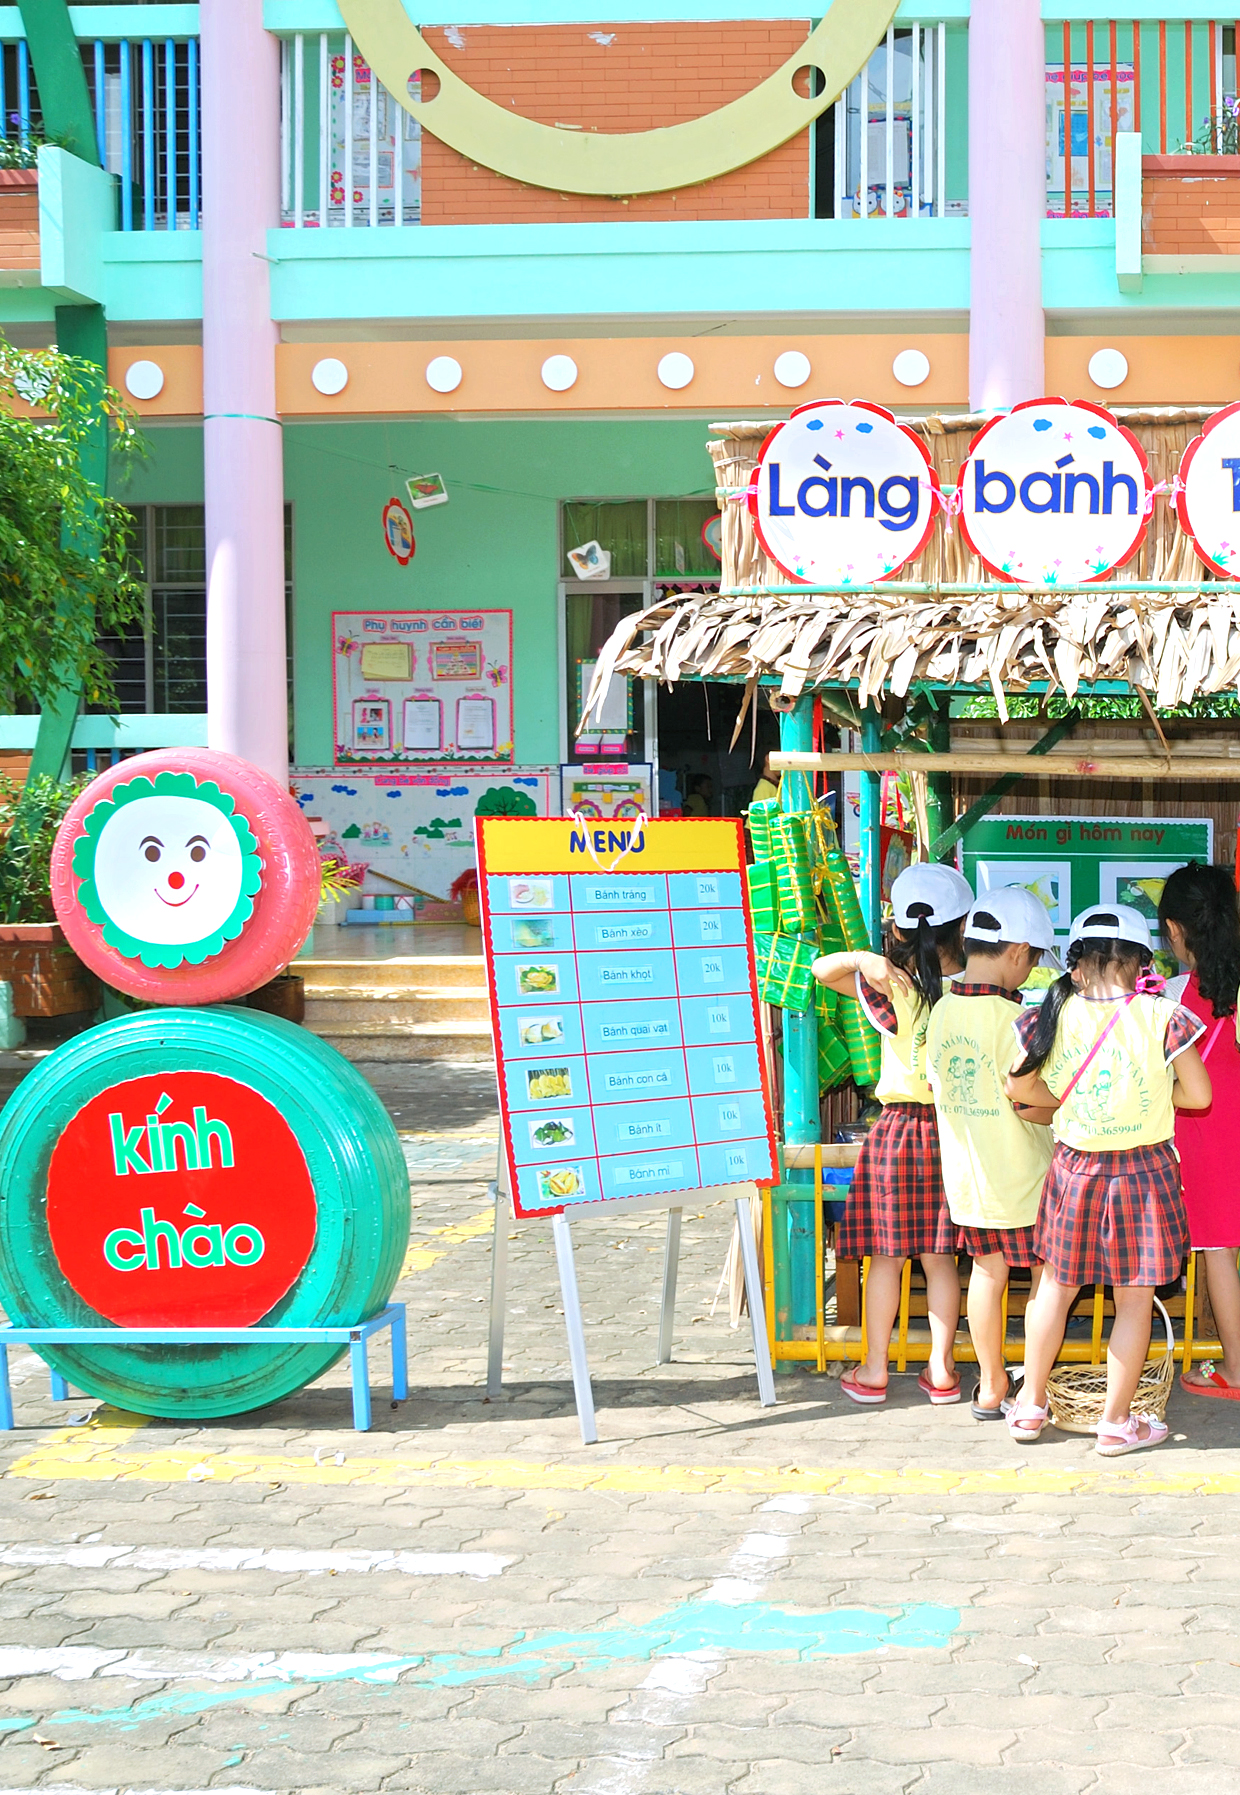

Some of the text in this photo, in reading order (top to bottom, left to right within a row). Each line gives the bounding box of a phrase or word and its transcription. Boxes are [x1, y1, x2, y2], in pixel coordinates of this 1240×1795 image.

[768, 452, 920, 532] Làng
[974, 453, 1138, 516] bánh
[391, 619, 427, 632] huynh
[1005, 823, 1166, 846] Món gì hôm nay
[569, 829, 646, 854] MENU
[700, 883, 716, 894] 20k
[595, 889, 647, 901] Bánh tráng
[703, 920, 719, 931] 20k
[601, 927, 649, 939] Bánh xèo
[705, 963, 721, 973] 20k
[603, 969, 652, 981] Bánh khọt
[711, 1013, 727, 1023] 10k
[603, 1025, 628, 1037] Bánh
[630, 1025, 651, 1037] quai
[716, 1063, 732, 1073] 10k
[609, 1071, 668, 1086] Bánh con cá
[722, 1110, 738, 1120] 10k
[108, 1092, 235, 1177] kính
[628, 1125, 653, 1136] Bánh
[729, 1155, 745, 1166] 10k
[629, 1169, 655, 1180] Bánh
[104, 1203, 265, 1271] chào
